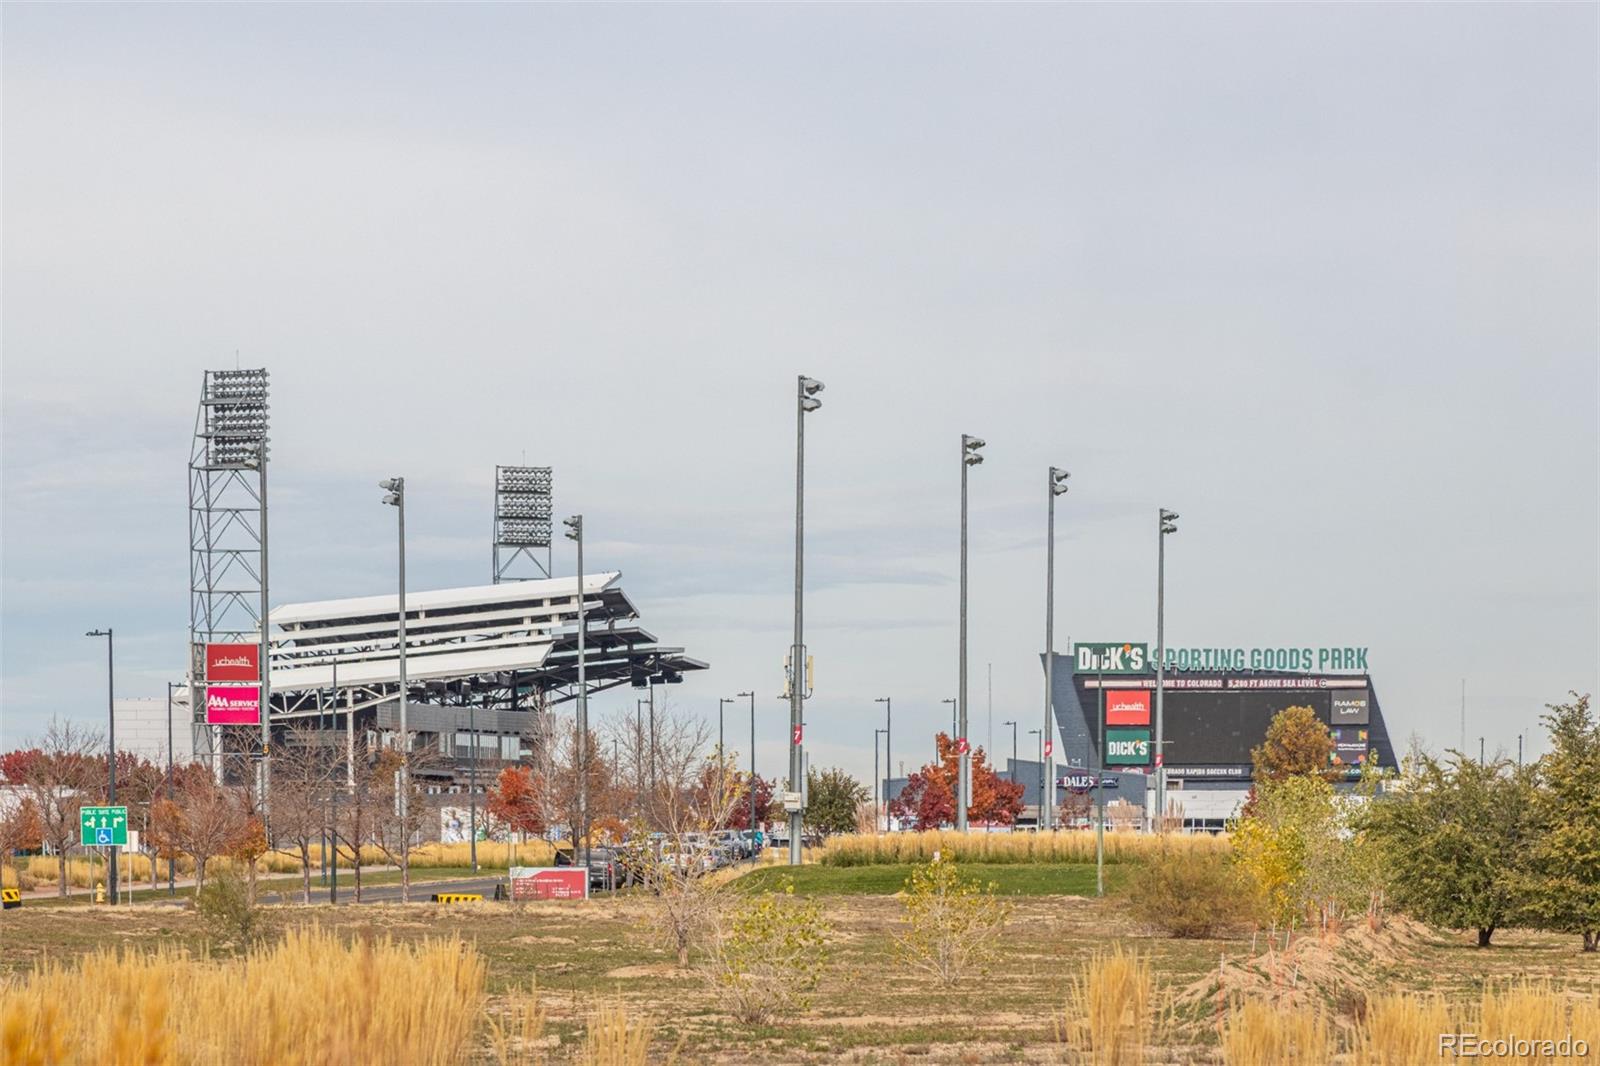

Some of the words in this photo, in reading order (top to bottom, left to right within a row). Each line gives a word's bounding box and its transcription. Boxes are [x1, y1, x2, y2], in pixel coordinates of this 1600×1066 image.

[215, 656, 250, 667] uchealth
[1078, 644, 1143, 671] DICK'S
[1151, 647, 1245, 671] SPORTING
[1250, 648, 1313, 670] GOODS
[1318, 647, 1368, 671] PARK
[1143, 680, 1175, 688] WELOME
[1176, 680, 1185, 688] TO
[1186, 679, 1222, 688] COLORADO
[1249, 679, 1258, 688] FT
[1259, 679, 1280, 688] ABOVE
[1282, 679, 1296, 688] SEA
[1297, 679, 1317, 688] LEVEL
[208, 695, 229, 707] AAA
[1112, 702, 1145, 711] uchealth
[794, 731, 800, 739] 7
[1108, 740, 1147, 755] DICK'S
